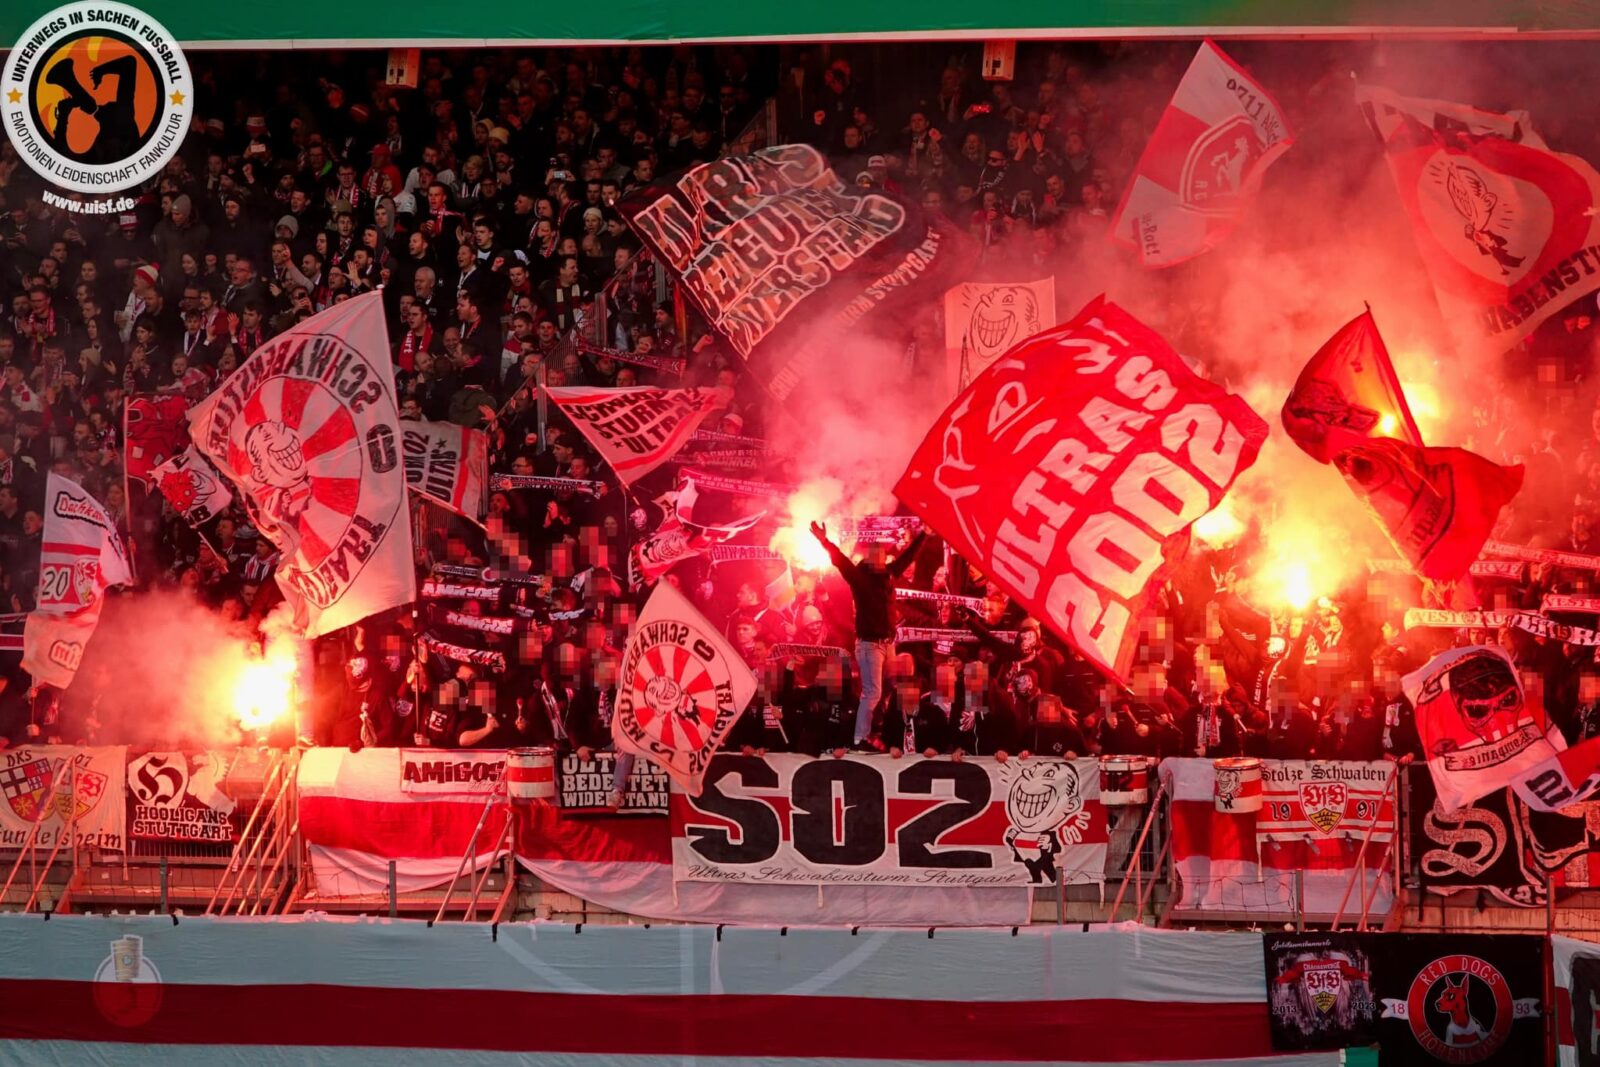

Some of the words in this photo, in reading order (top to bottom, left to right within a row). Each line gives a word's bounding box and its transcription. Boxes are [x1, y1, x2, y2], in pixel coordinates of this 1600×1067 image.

[992, 355, 1178, 599] ULTRAS
[1045, 403, 1245, 669] 2002
[42, 569, 70, 601] 20
[6, 749, 33, 768] DKS
[1311, 764, 1387, 781] Schwaben
[562, 774, 668, 793] BEDETET
[1271, 802, 1291, 821] 19
[1355, 800, 1378, 820] 91
[0, 823, 122, 849] unelsheim
[134, 822, 233, 841] STUTTGART
[687, 864, 747, 880] Ultras
[750, 865, 911, 883] Schwabensturm
[915, 868, 1017, 888] Stuttgart
[1419, 959, 1448, 986] RED
[1461, 957, 1500, 986] DOGS
[1272, 1004, 1298, 1016] 2013
[1351, 1000, 1377, 1012] 2023
[1391, 1003, 1405, 1015] 18
[1515, 1002, 1530, 1015] 93
